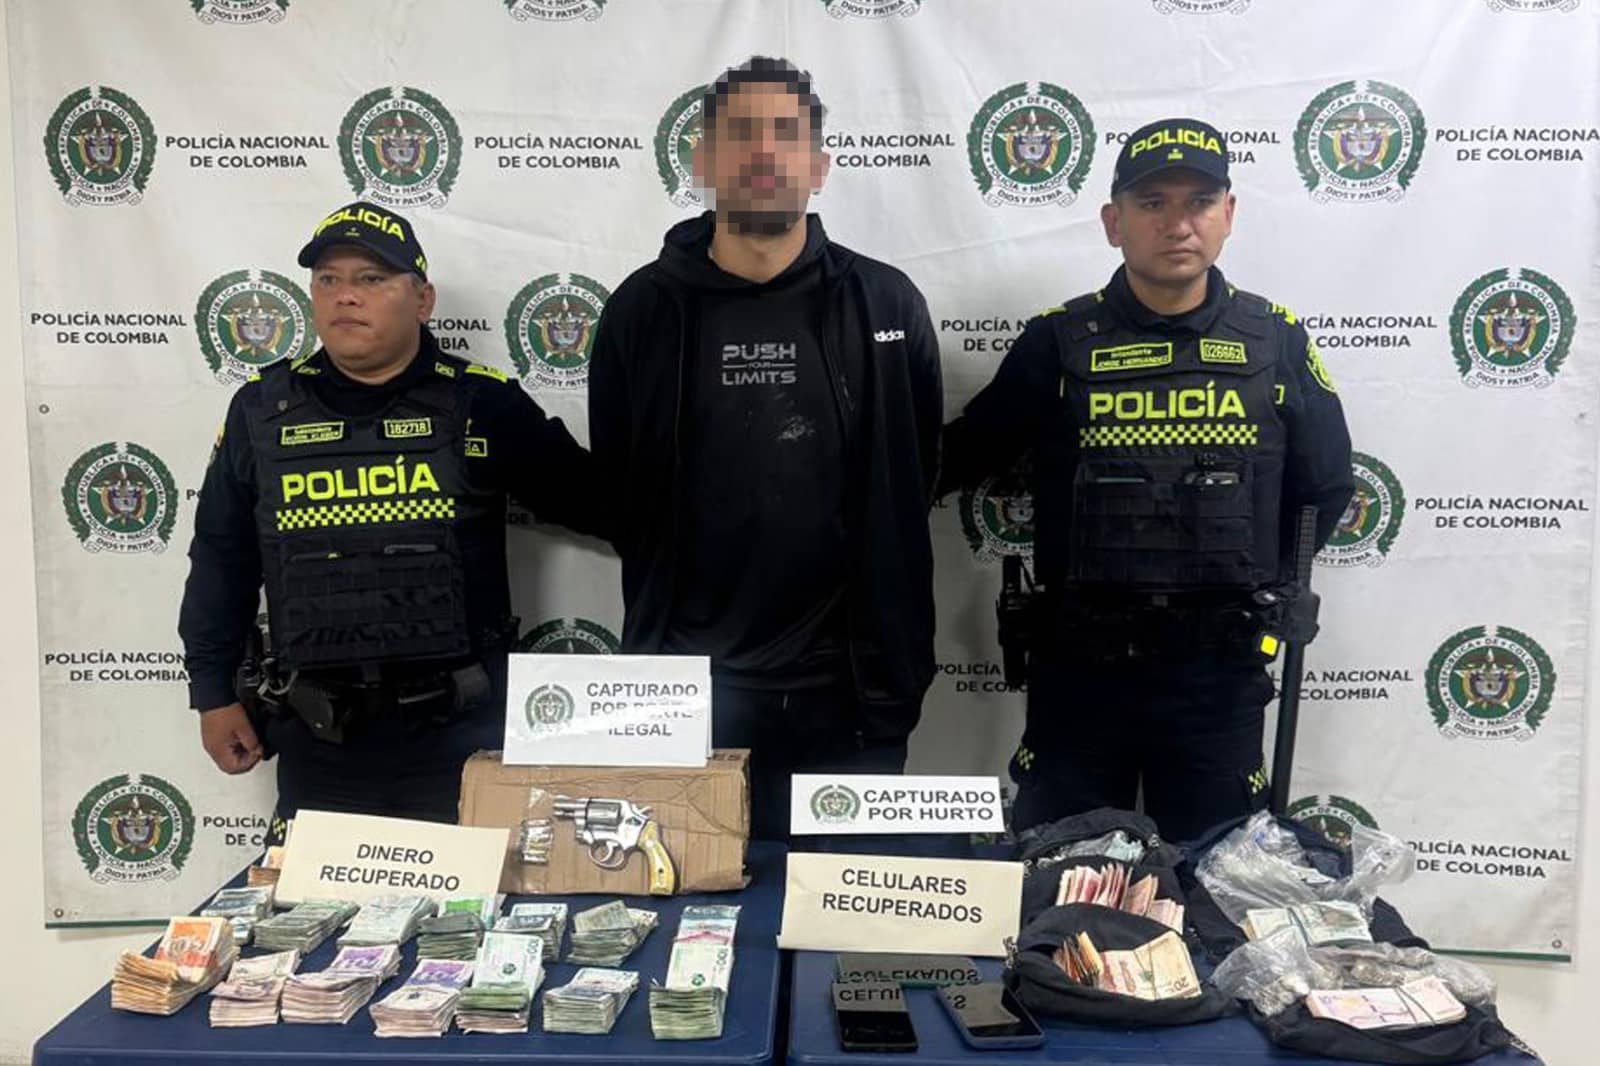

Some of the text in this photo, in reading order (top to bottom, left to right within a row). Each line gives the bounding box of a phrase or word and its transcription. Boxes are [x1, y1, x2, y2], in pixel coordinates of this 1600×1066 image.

[1436, 125, 1600, 142] POLICÍA NACIONA
[166, 134, 329, 149] POLICÍA NACIONAL
[474, 133, 643, 150] POLICÍA NACIONAL
[861, 134, 955, 148] NACIONAL
[1130, 128, 1222, 159] POLICÍA
[836, 154, 931, 168] COLOMBIA
[1457, 148, 1583, 161] DE COLOMBIA
[190, 156, 307, 168] DE COLOMBIA
[498, 156, 620, 168] DE COLOMBIA
[998, 190, 1020, 202] DIOS
[1030, 190, 1062, 204] PATRIA
[311, 207, 405, 242] POLICÍA
[31, 311, 187, 326] POLICÍA NACIONAL
[427, 318, 492, 331] CIONAL
[941, 317, 1012, 332] POLICÍA
[1340, 316, 1437, 329] NACIONAL
[56, 332, 168, 344] DE COLOMBIA
[1316, 335, 1411, 348] COLOMBIA
[722, 343, 796, 361] PUSH
[964, 339, 986, 352] DE
[722, 370, 796, 386] LIMITS
[1089, 379, 1246, 420] POLICÍA
[390, 420, 426, 435] 182718
[281, 455, 440, 503] POLICÍA
[1415, 494, 1589, 511] POLICÍA NACIONAL
[1435, 516, 1561, 529] DE COLOMBIA
[45, 649, 187, 664] POLICÍA NACION
[70, 670, 188, 682] DE COLOMBIA
[1322, 670, 1413, 682] NACIONAL
[586, 683, 698, 697] CAPTURADO
[956, 681, 978, 692] DE
[1298, 688, 1389, 700] COLOMBIA
[608, 724, 672, 736] ILEGAL
[864, 790, 996, 804] CAPTURADO
[203, 814, 268, 828] POLICÍA
[868, 808, 994, 820] POR HURTO
[226, 834, 247, 846] DE
[356, 843, 434, 865] DINERO
[1408, 840, 1572, 862] OLICÍA NACIONAL
[1416, 859, 1546, 878] DE COLOMBIA
[320, 865, 460, 892] RECUPERADO
[842, 868, 968, 896] CELULARES
[822, 892, 983, 924] RECUPERADOS
